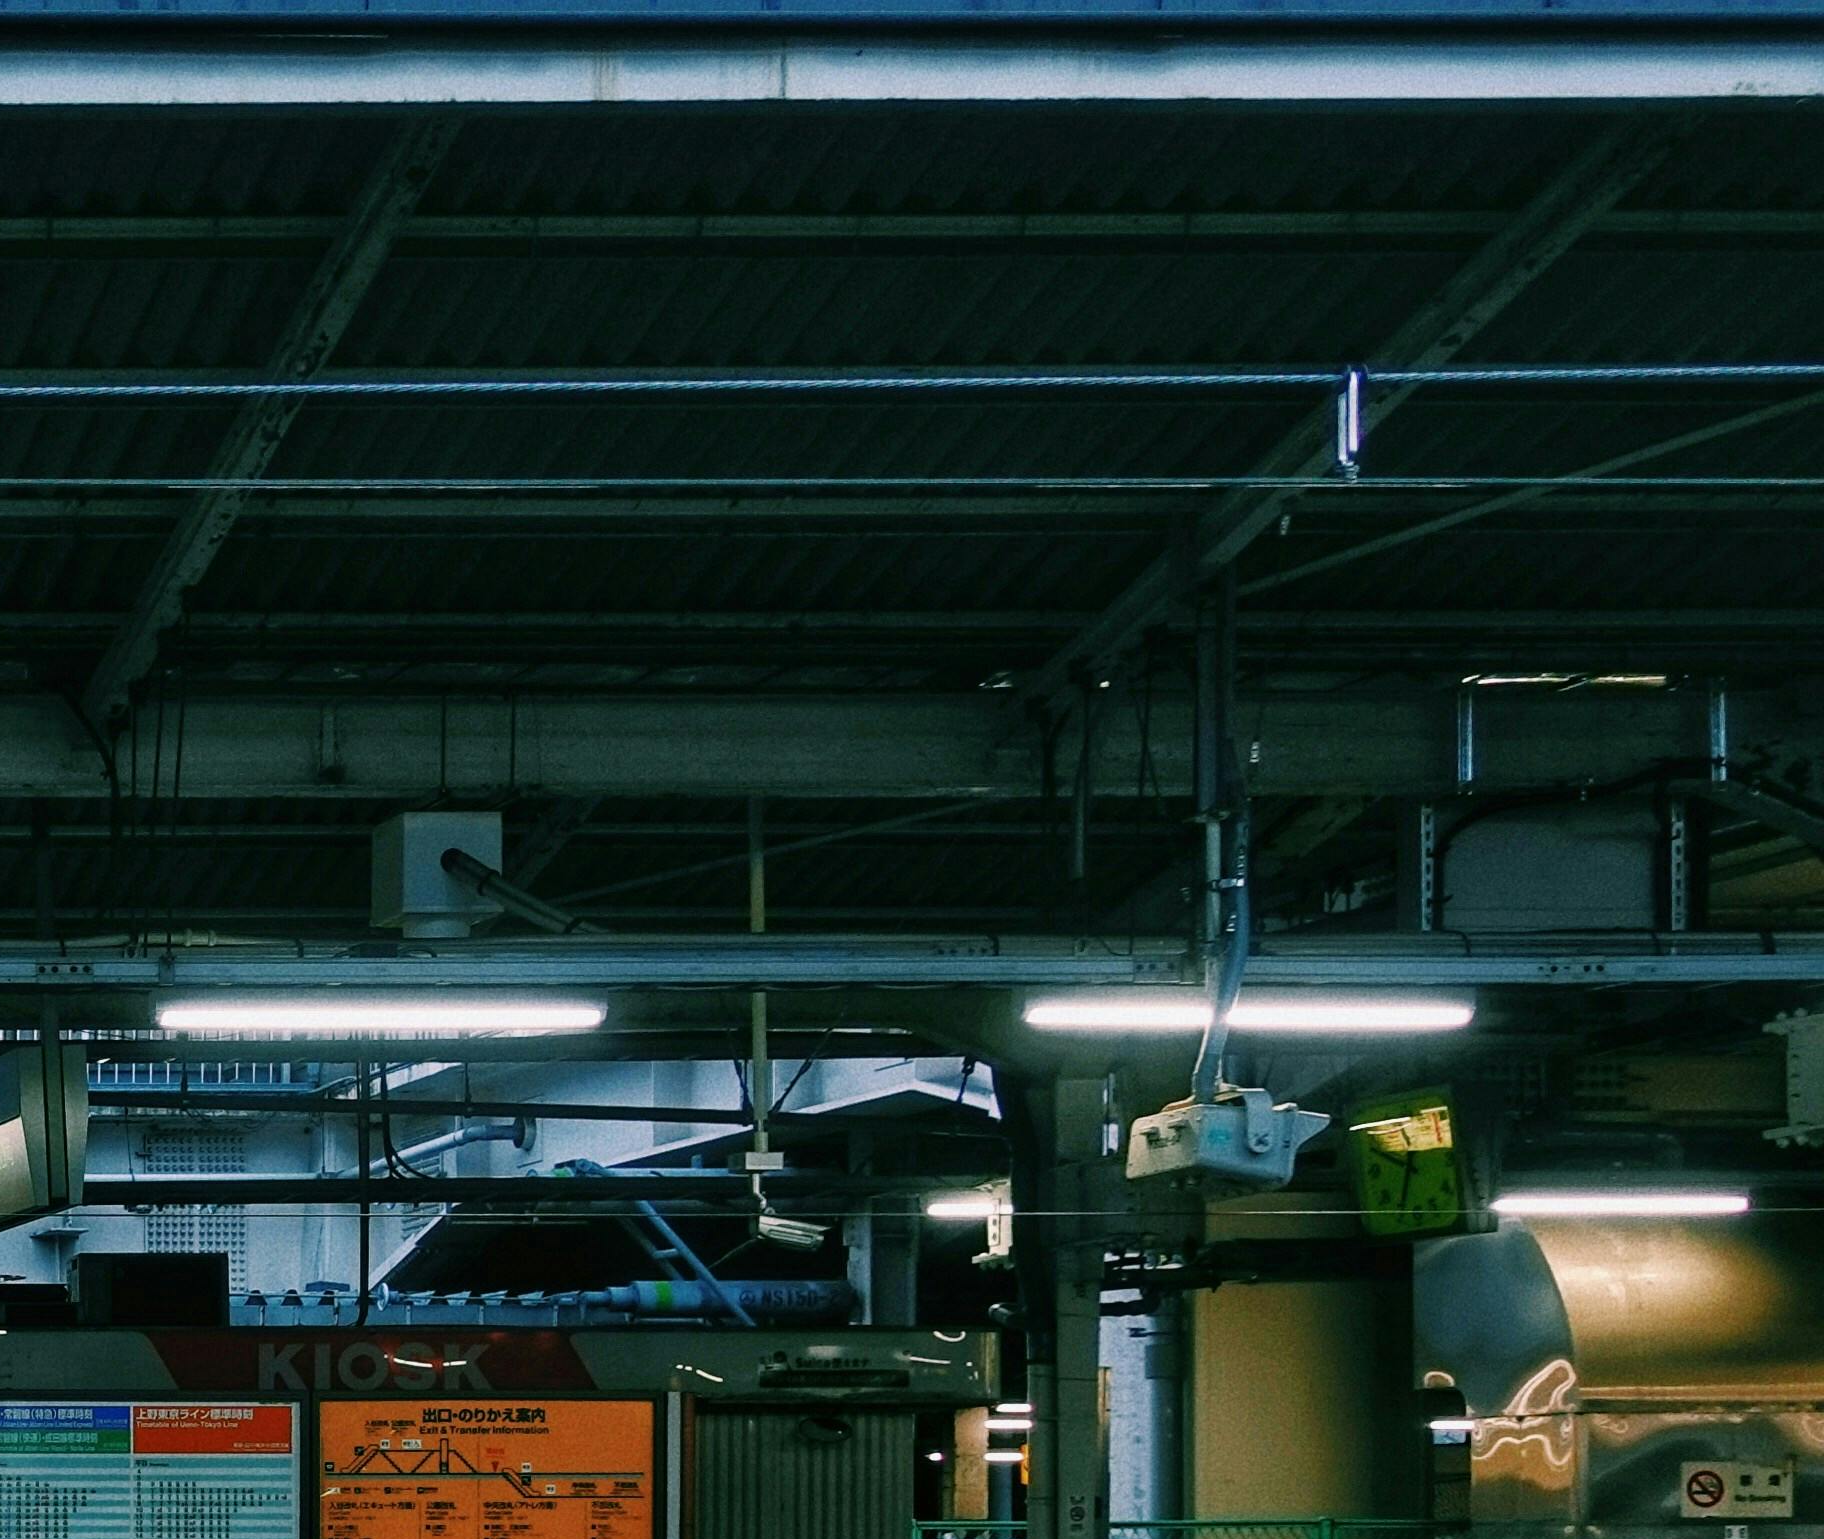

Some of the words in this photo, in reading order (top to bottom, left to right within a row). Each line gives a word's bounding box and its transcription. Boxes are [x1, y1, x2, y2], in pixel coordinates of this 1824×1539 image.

[258, 1342, 492, 1391] KIOSK
[422, 1407, 545, 1422] 出口・のりかえ案内
[419, 1426, 438, 1434] Exit
[450, 1425, 491, 1434] Transfer
[493, 1425, 549, 1434] Information
